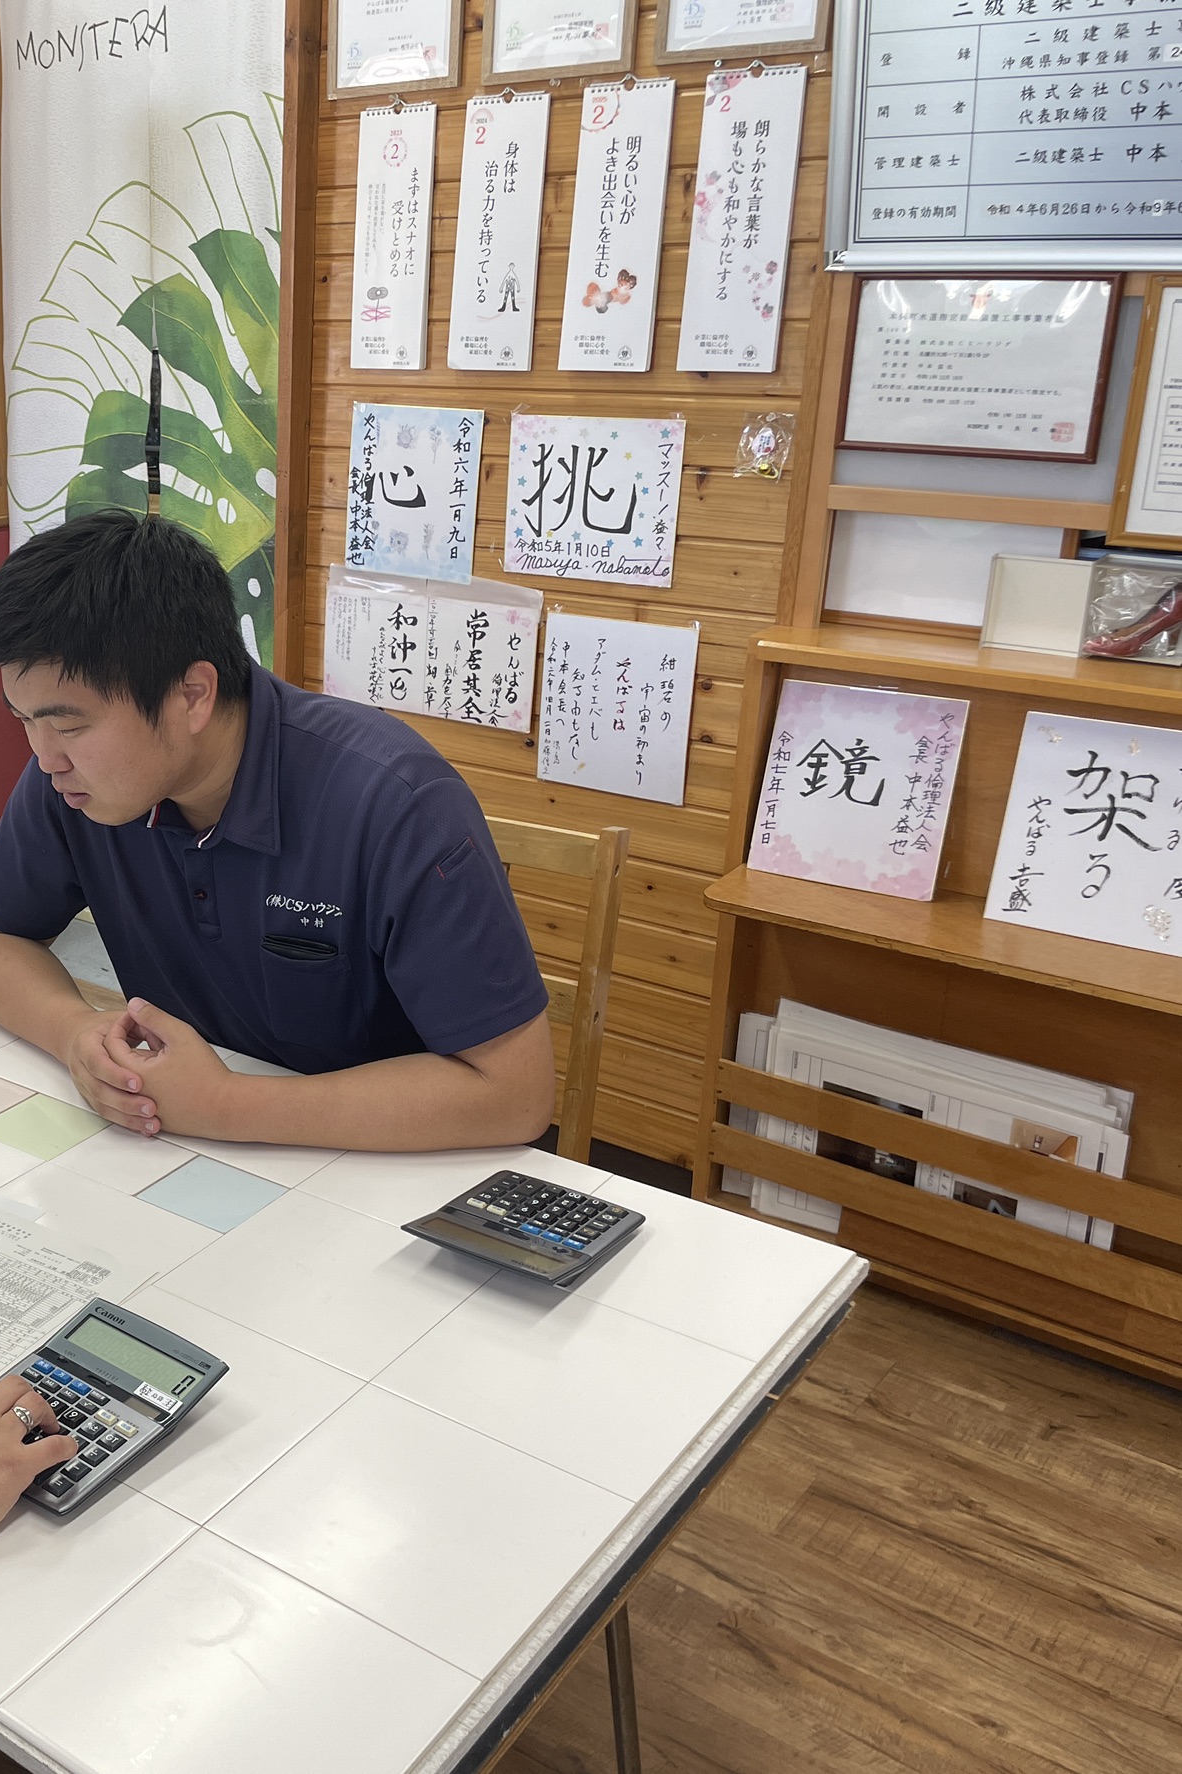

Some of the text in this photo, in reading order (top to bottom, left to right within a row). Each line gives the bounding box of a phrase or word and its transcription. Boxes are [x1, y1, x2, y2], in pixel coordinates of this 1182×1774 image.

[16, 5, 168, 71] MONSTERA
[1002, 49, 1129, 70] 沖縄県知事登録
[592, 105, 605, 124] 2
[719, 95, 731, 112] 2
[475, 126, 486, 144] 2
[1015, 147, 1104, 164] 二級建築士
[503, 141, 519, 193] 身体は
[619, 136, 642, 225] 明るい心が
[743, 119, 770, 249] 朗らかな言葉が
[874, 154, 960, 170] 管理建築士
[404, 167, 420, 276] まずはスナオに
[476, 160, 499, 304] 治る力を持っている
[594, 138, 619, 278] よき出会いを生む
[716, 121, 748, 301] 場も心も和やかにする
[872, 205, 957, 220] 登録の有効期間
[389, 200, 404, 277] 受けとめる
[379, 465, 426, 508] 心
[447, 417, 474, 559] 令和六年一月九日
[521, 443, 638, 538] 挑
[514, 538, 611, 558] 令和5年1月10日
[760, 730, 794, 844] 令和七年一月七日
[796, 738, 886, 807] 鏡
[909, 711, 955, 852] やんばる倫理法人会
[94, 1306, 126, 1326] Canon
[50, 1400, 59, 1408] 8
[171, 1374, 195, 1396] 0
[104, 1433, 119, 1444] GT
